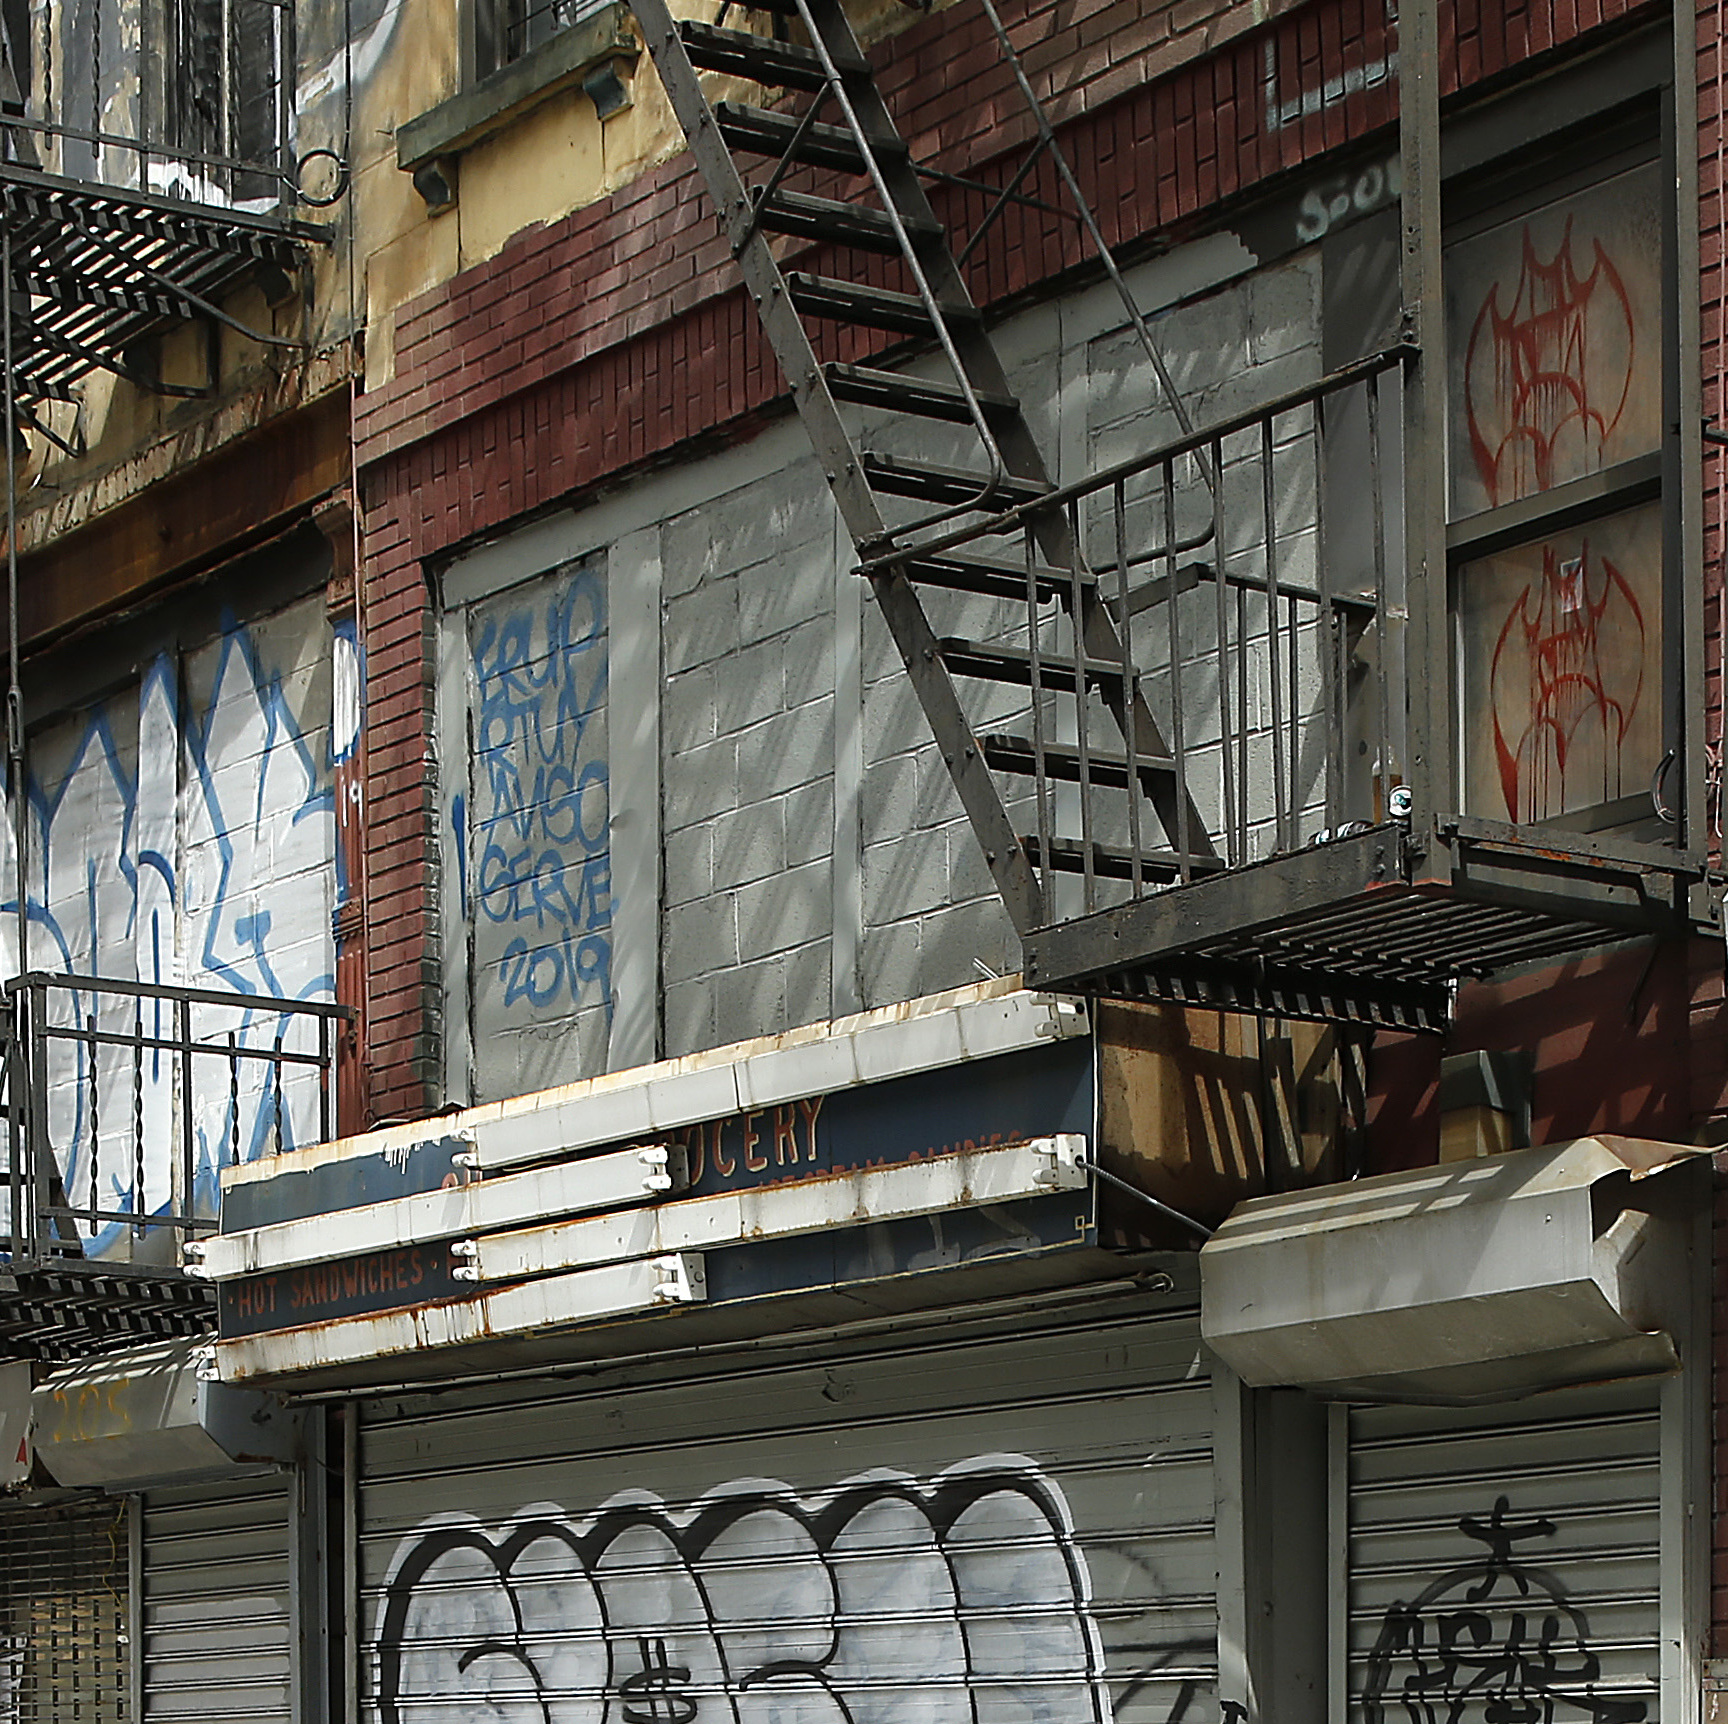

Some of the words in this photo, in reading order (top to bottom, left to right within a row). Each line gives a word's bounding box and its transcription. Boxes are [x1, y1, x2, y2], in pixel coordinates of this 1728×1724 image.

[480, 846, 613, 930] SERVE
[500, 930, 614, 1034] 2019
[239, 1277, 277, 1318] HOT
[290, 1250, 424, 1309] SANDWICHES
